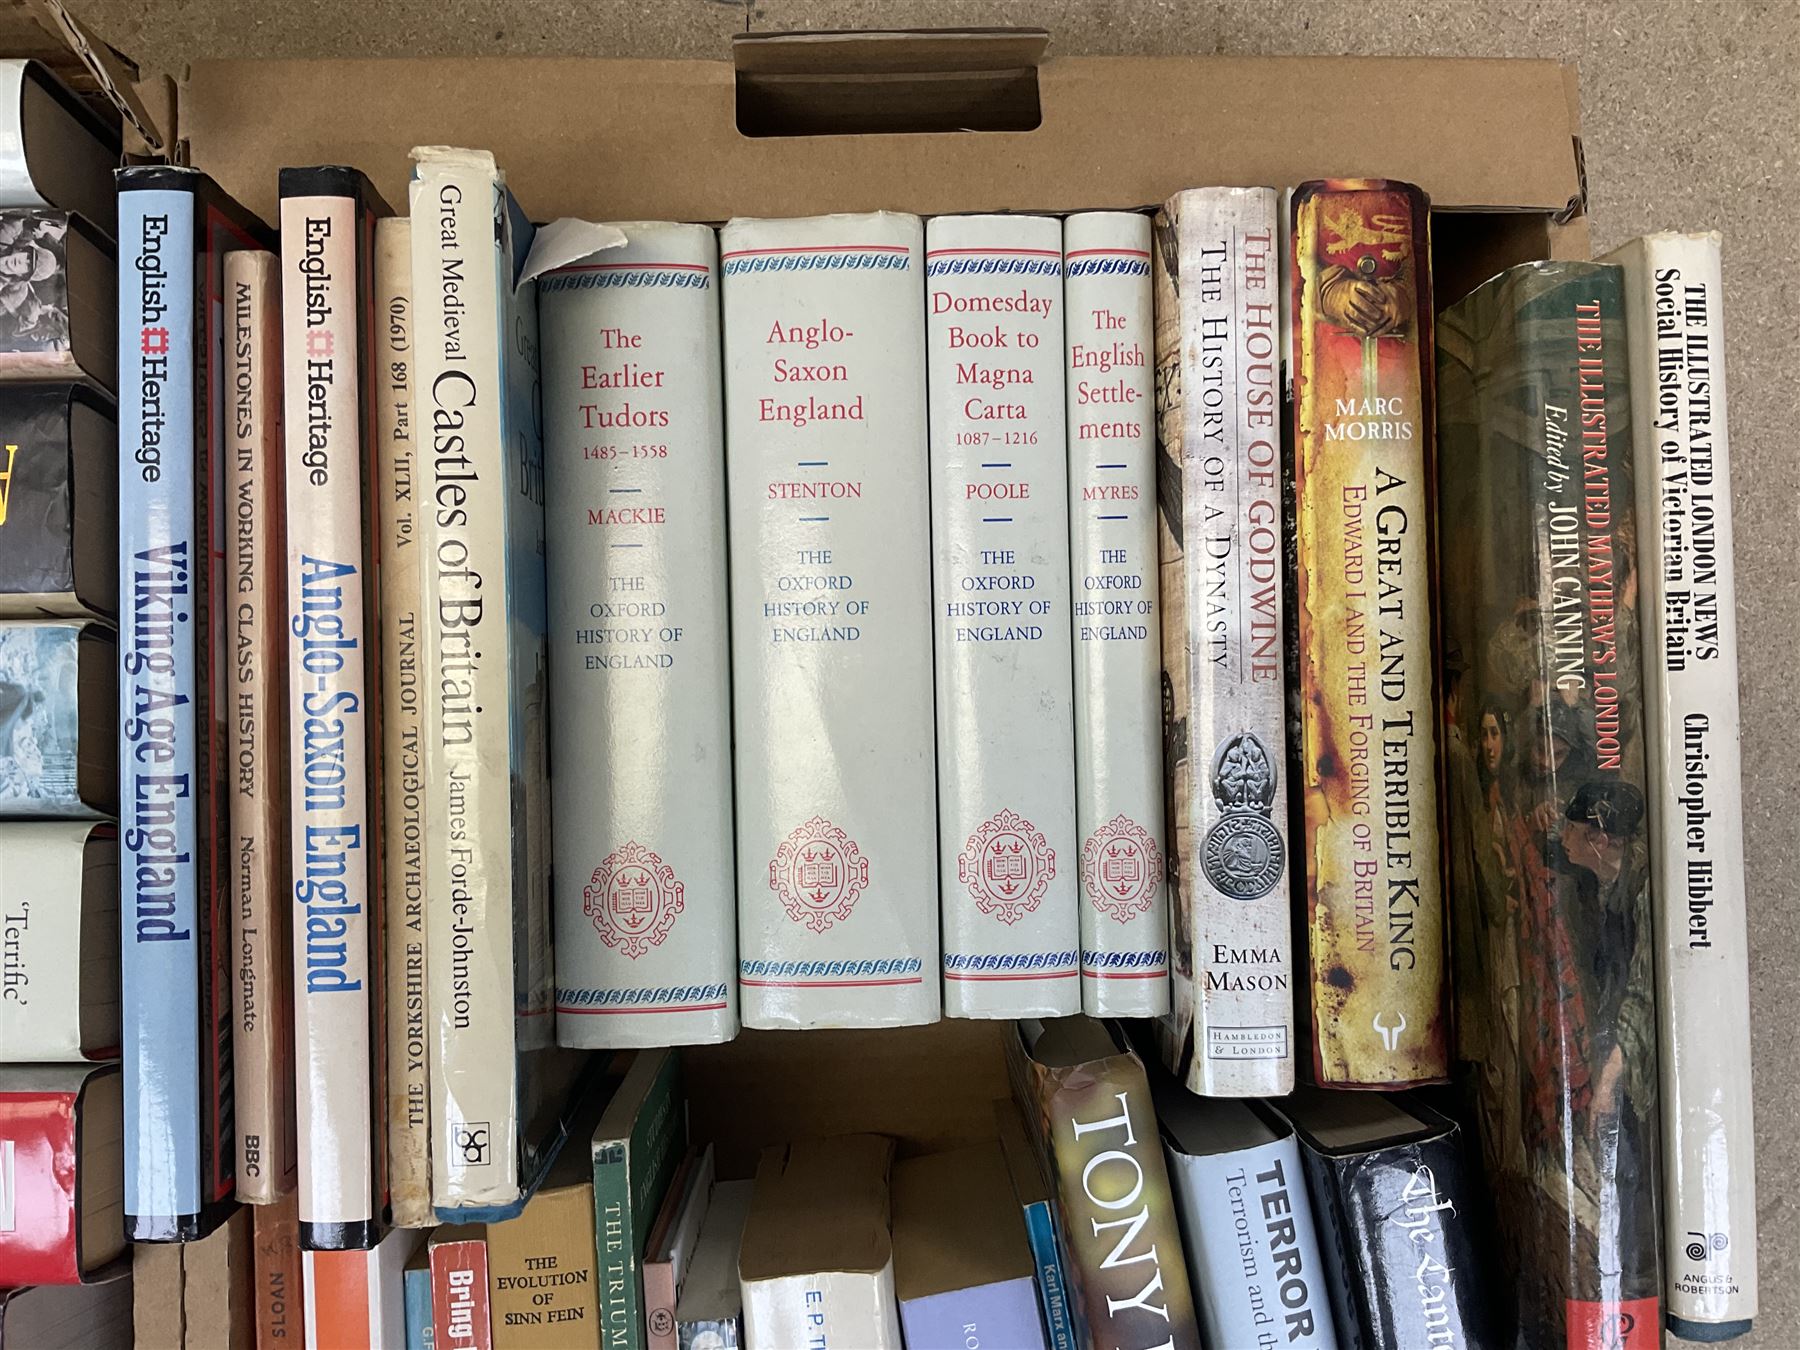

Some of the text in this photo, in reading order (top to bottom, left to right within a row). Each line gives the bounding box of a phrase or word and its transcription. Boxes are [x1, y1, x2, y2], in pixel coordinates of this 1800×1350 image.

[1201, 241, 1227, 303] THE
[932, 290, 1053, 319] Domesday
[1092, 310, 1126, 329] The
[1575, 299, 1603, 352] THE
[600, 328, 642, 349] The
[766, 319, 854, 349] Anglo-
[948, 326, 1039, 348] Book to
[135, 214, 168, 482] English Heritage
[299, 217, 333, 486] English Heritage
[1072, 343, 1145, 373] English
[581, 363, 665, 389] Earlier
[774, 359, 848, 382] Saxon
[956, 362, 1034, 389] Magna
[1078, 380, 1143, 405] Settle-
[579, 403, 669, 428] Tudors
[759, 396, 864, 427] England
[964, 398, 1027, 420] Carta
[1335, 397, 1402, 416] MARC
[389, 296, 413, 548] Vol. XLII, Part 168 (1970)
[1079, 420, 1141, 440] ments
[1324, 422, 1412, 441] MORRIS
[1244, 228, 1277, 683] THE HOUSE OF GODWINE
[1578, 357, 1612, 529] ILLUSTRATED
[432, 184, 487, 748] Great Medieval Castles of Britain
[1203, 457, 1225, 492] OF
[1653, 268, 1692, 672] Social History of Victorian Britain
[1684, 283, 1719, 661] THE ILLUSTRATED LONDON NEWS
[768, 482, 862, 499] STENTON
[965, 484, 1030, 499] POOLE
[1083, 486, 1139, 500] MYRES
[1375, 466, 1407, 496] A
[587, 508, 666, 525] MACKIE
[1204, 504, 1225, 521] A
[235, 281, 255, 798] MILESTONES IN WORKING CLASS HISTORY
[1543, 403, 1585, 690] Edited by JOHN CANNING
[797, 550, 832, 565] THE
[981, 550, 1015, 564] THE
[1099, 549, 1127, 563] THE
[1376, 504, 1408, 620] GREAT
[609, 576, 645, 591] THE
[778, 576, 852, 591] OXFORD
[961, 576, 1035, 590] OXFORD
[1084, 575, 1142, 590] OXFORD
[590, 602, 666, 617] OXFORD
[764, 601, 870, 617] HISTORY OF
[947, 601, 1051, 616] HISTORY OF
[1075, 601, 1153, 616] HISTORY OF
[576, 628, 683, 643] HISTORY OF
[773, 627, 860, 642] ENGLAND
[956, 626, 1043, 642] ENGLAND
[1080, 626, 1147, 641] ENGLAND
[1345, 607, 1366, 655] AND
[585, 654, 673, 670] ENGLAND
[1379, 629, 1405, 702] AND
[1347, 662, 1367, 707] THE
[1592, 672, 1621, 770] LONDON
[125, 541, 190, 943] Viking Age England
[292, 554, 361, 993] Anglo-Saxon England
[1352, 823, 1371, 851] OF
[1678, 712, 1714, 950] Christopher Hibbert
[400, 612, 424, 1128] THE YORKSHIRE ARCHAEOLOGICAL JOURNAL
[450, 772, 474, 1029] James Forde-Johnston
[240, 836, 257, 1033] Norman Longmate
[1215, 1046, 1225, 1055] &
[245, 1135, 260, 1177] BBC
[1072, 1091, 1171, 1323] TONY
[1389, 1164, 1457, 1243] The
[605, 1201, 623, 1253] THE
[1225, 1167, 1259, 1279] Terrorism
[1248, 1285, 1274, 1326] and
[1256, 1159, 1315, 1343] TERROR
[525, 1256, 558, 1270] THE
[497, 1270, 588, 1290] EVOLUTION
[1043, 1264, 1060, 1293] Karl
[1674, 1282, 1739, 1294] ROBERTSON
[1683, 1274, 1723, 1284] ANGUS
[270, 1272, 286, 1338] SLOAN
[448, 1269, 475, 1338] Bring
[532, 1293, 554, 1306] OF
[1050, 1295, 1064, 1330] Marx
[505, 1307, 584, 1326] SINN FEIN
